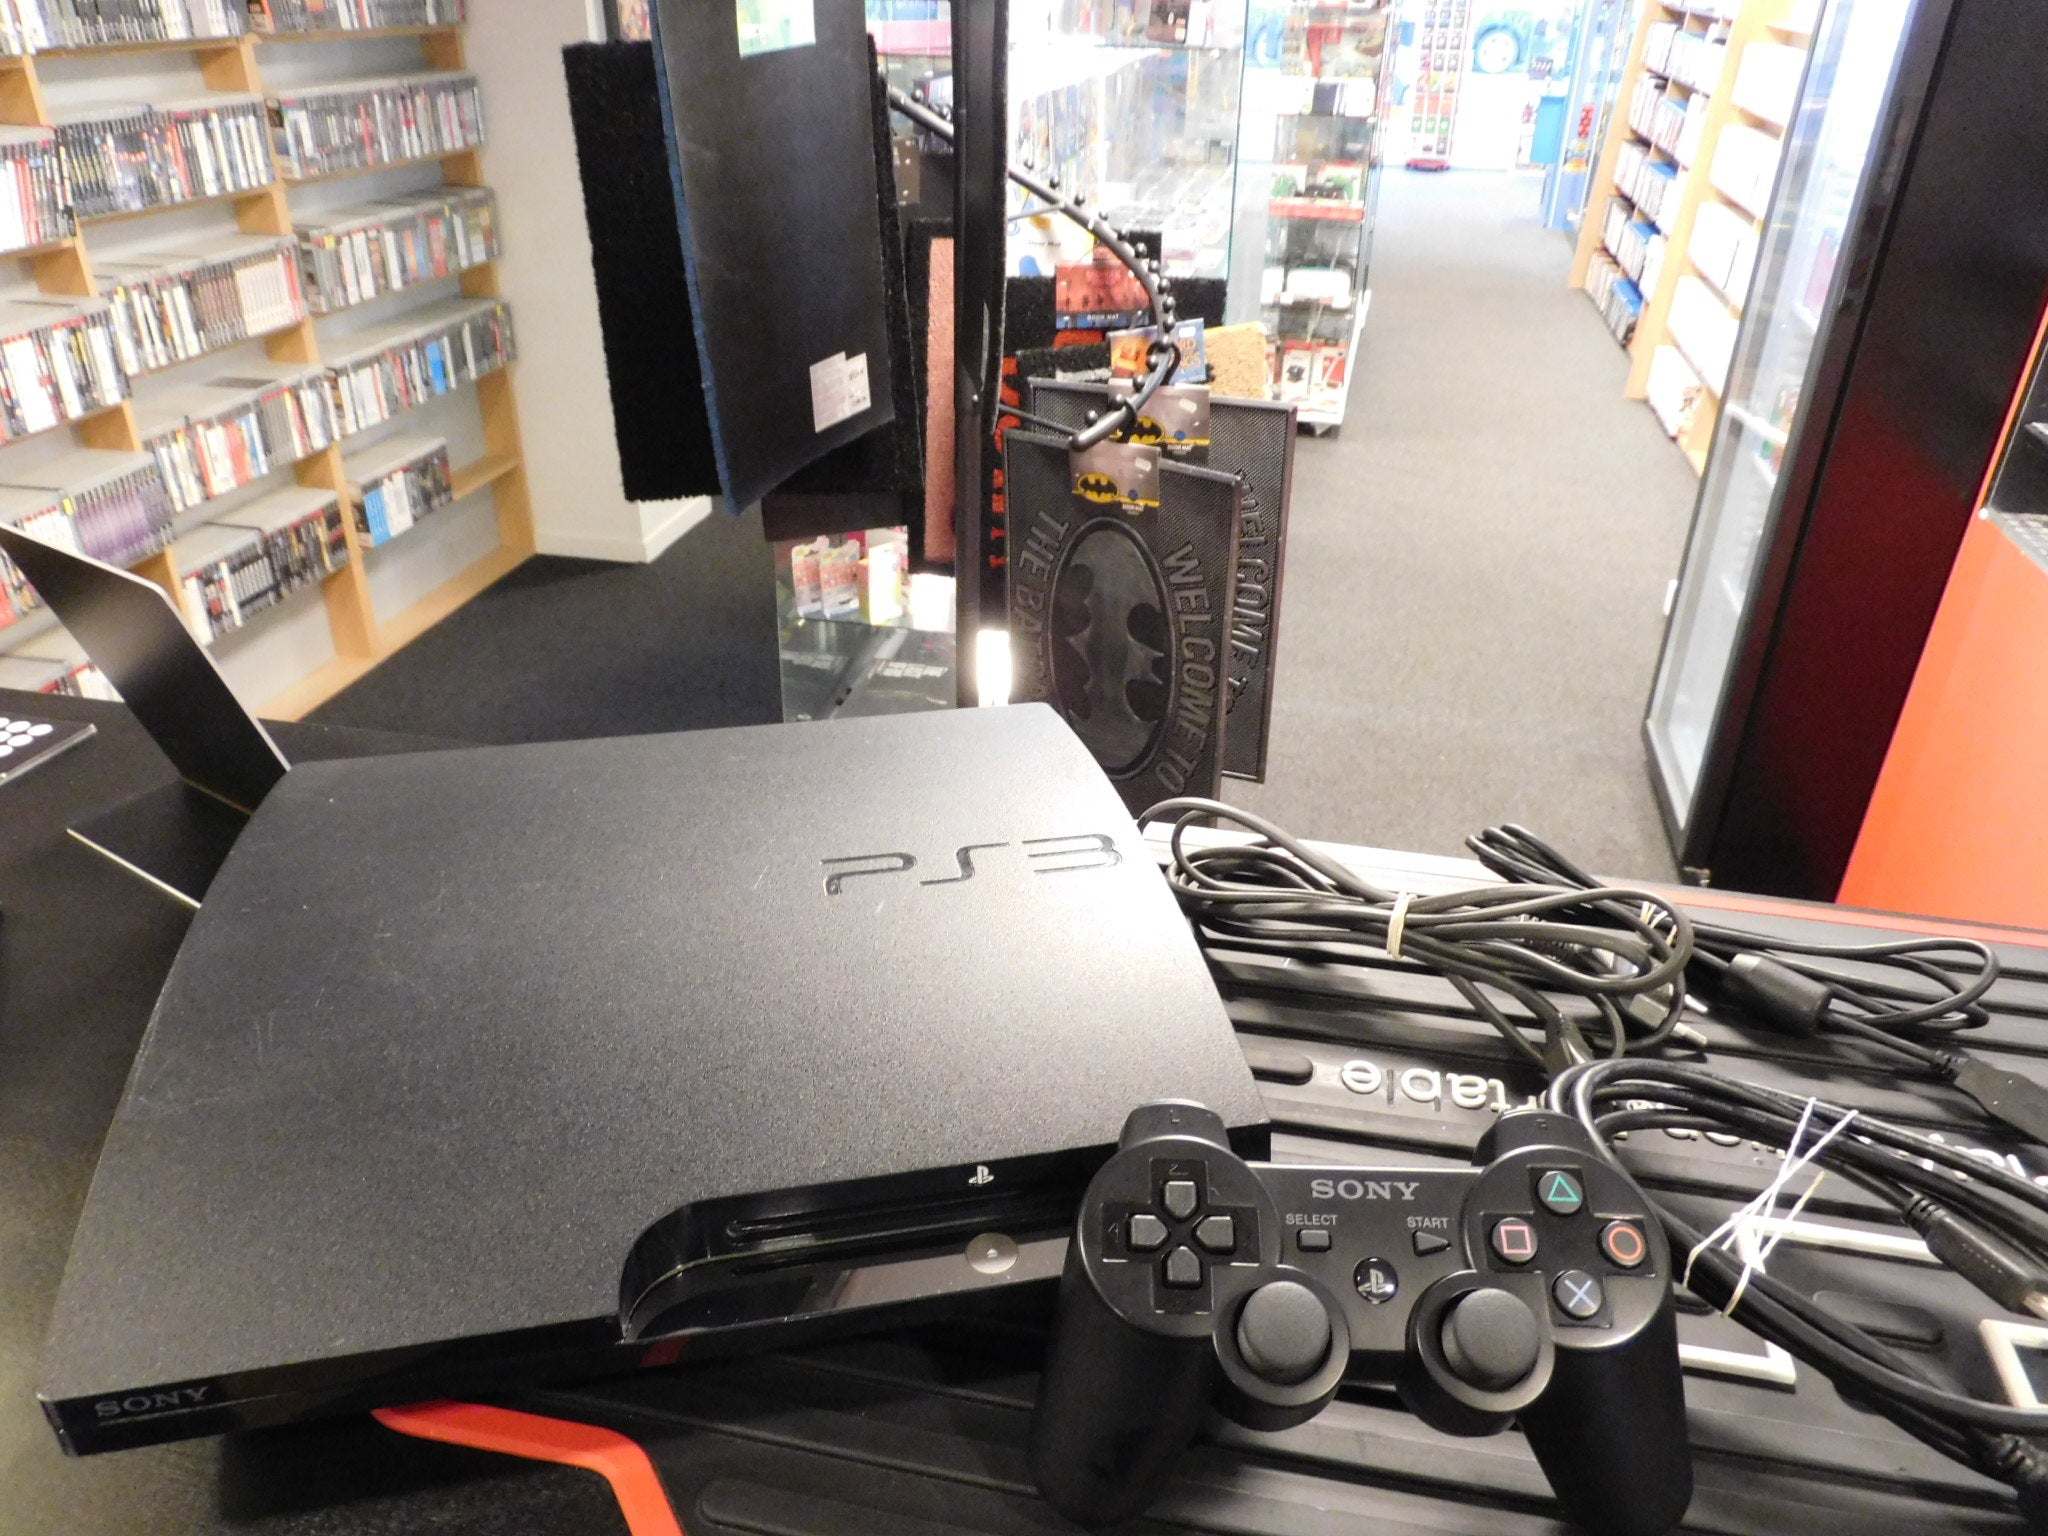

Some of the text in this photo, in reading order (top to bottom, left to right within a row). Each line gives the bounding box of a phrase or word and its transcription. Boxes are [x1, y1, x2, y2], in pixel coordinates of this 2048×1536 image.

[1018, 509, 1070, 583] THE
[1155, 542, 1216, 795] WELCOME TO
[820, 833, 1123, 897] PS3
[1310, 1178, 1420, 1201] SONY
[1285, 1213, 1450, 1229] SELECT START
[94, 1385, 209, 1419] SONY
